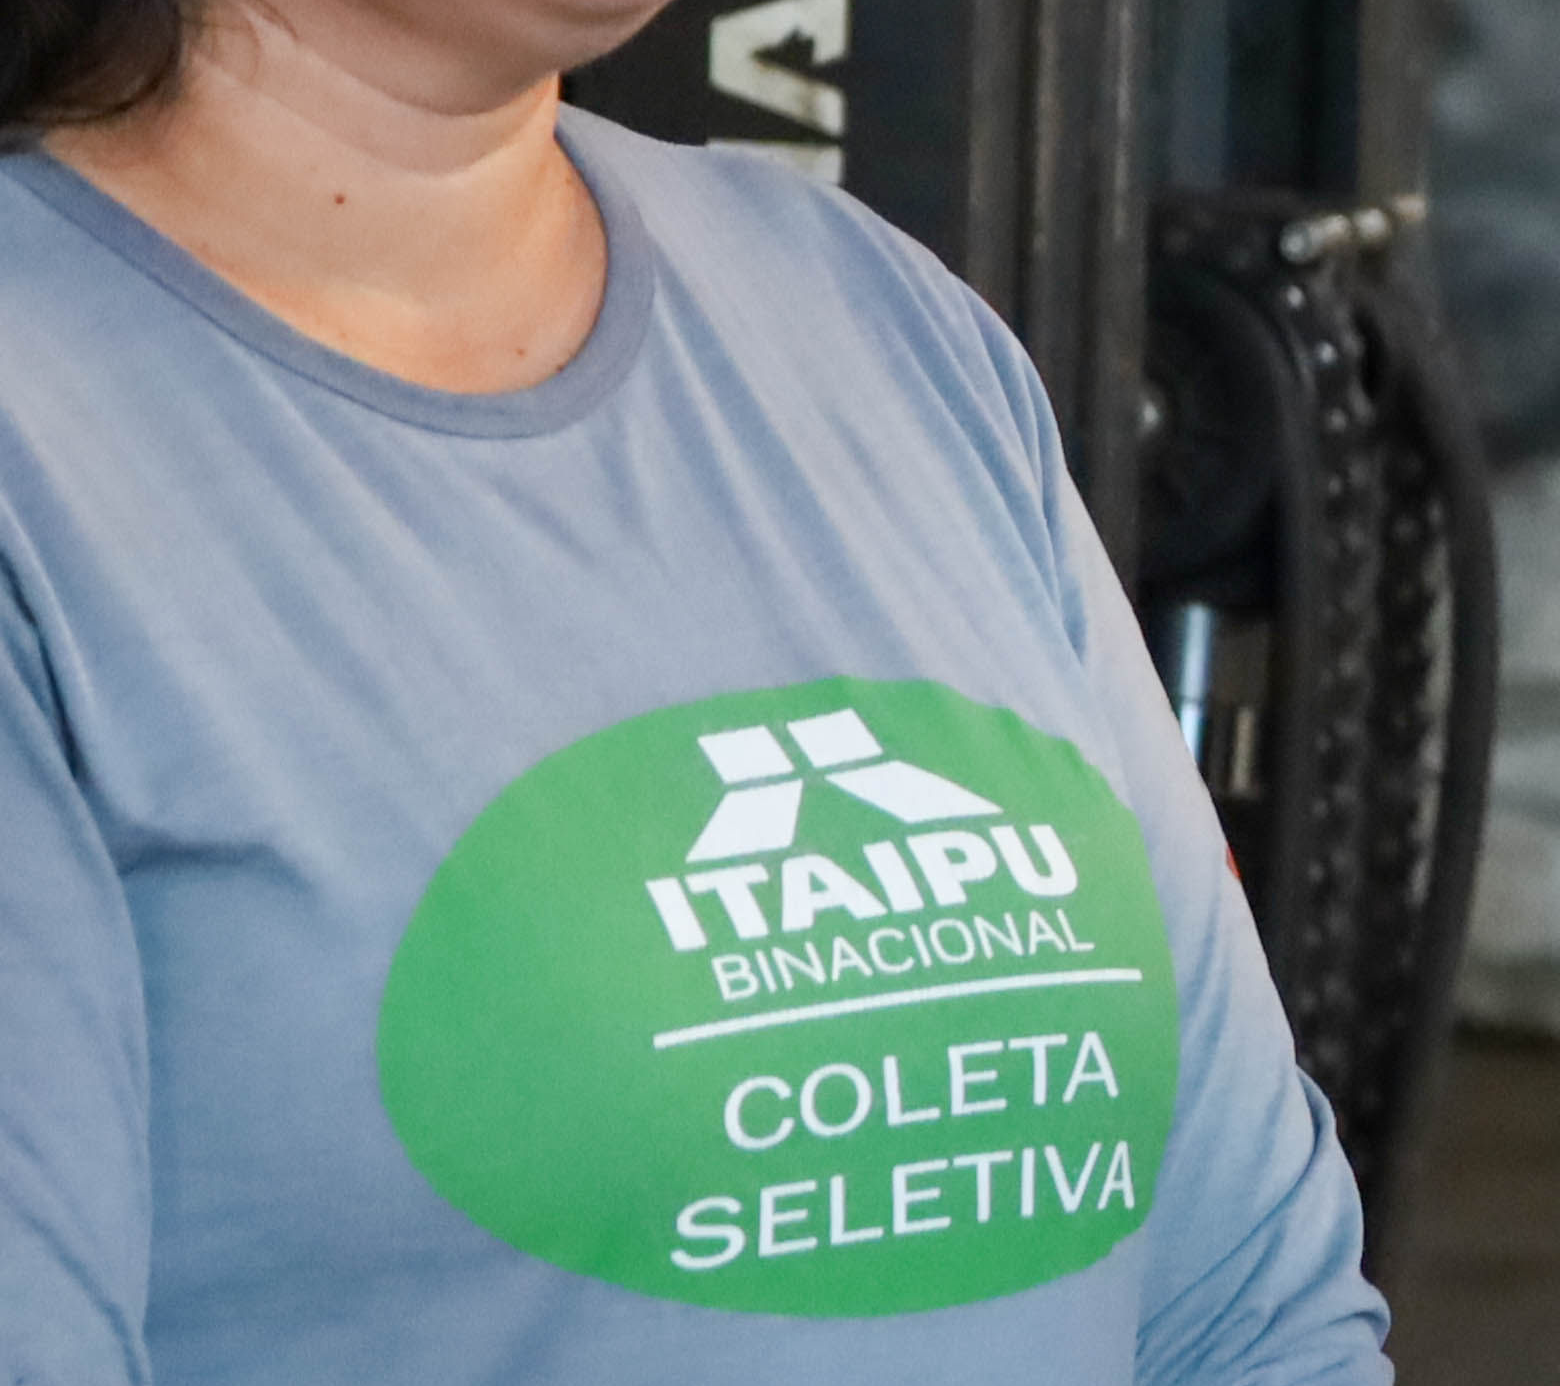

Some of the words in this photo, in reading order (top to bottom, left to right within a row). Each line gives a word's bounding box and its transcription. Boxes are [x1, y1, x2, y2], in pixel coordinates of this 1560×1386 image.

[645, 825, 1079, 951] ITAIPU
[709, 909, 1096, 1002] BINACIONAL
[723, 1031, 1120, 1151] COLETA
[669, 1140, 1137, 1271] SELETIVA
